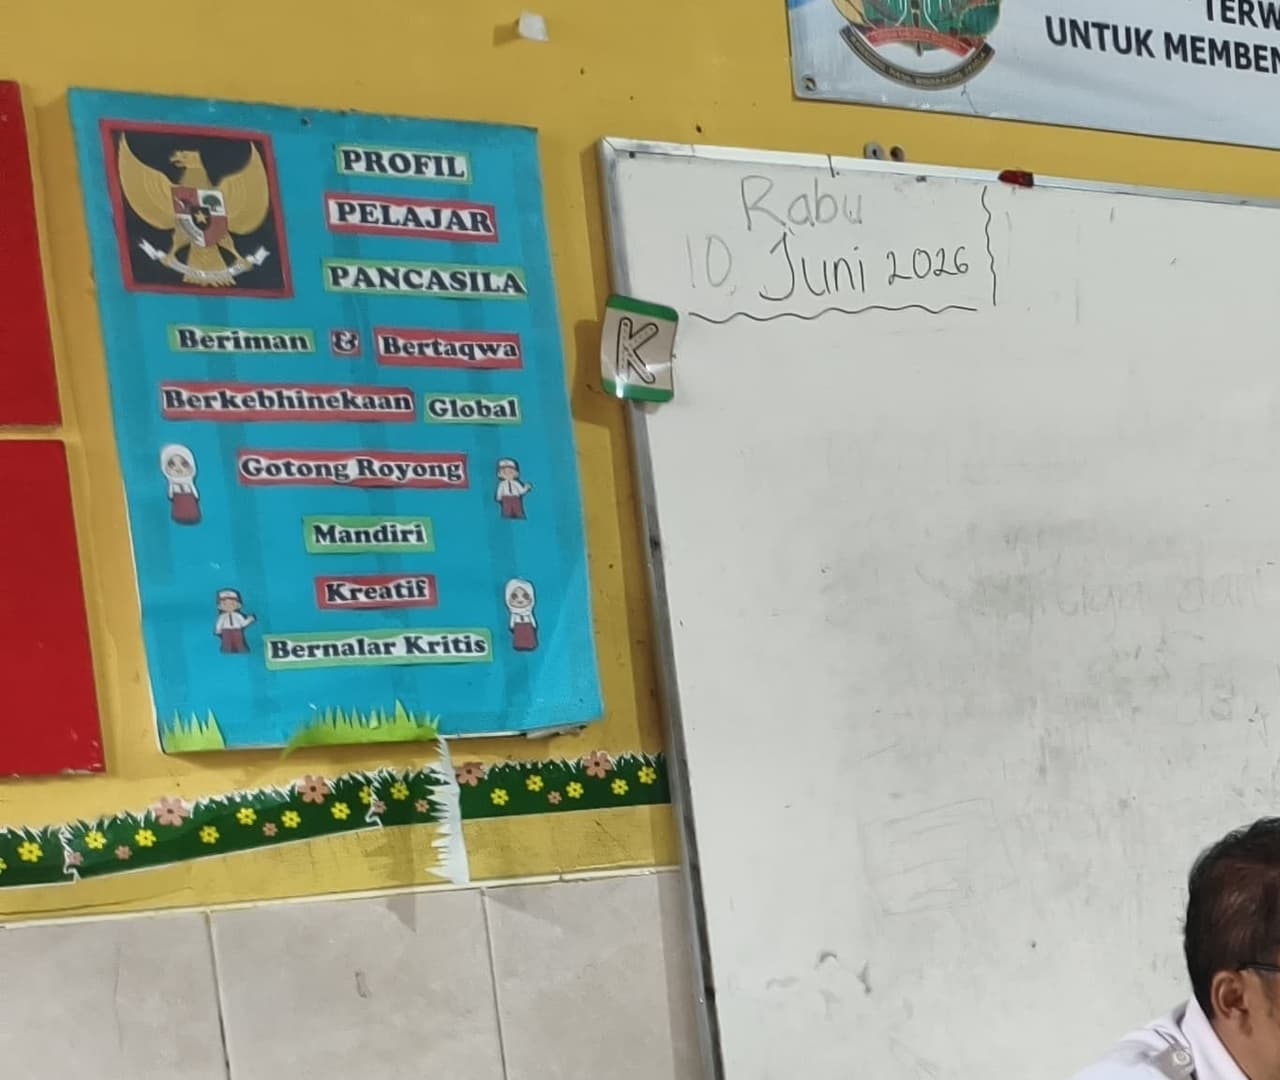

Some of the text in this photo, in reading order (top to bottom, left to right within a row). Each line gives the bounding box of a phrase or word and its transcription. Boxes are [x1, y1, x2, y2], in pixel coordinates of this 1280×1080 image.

[1045, 16, 1154, 59] UNTUK
[341, 148, 467, 180] PROFIL
[335, 201, 491, 235] PELAJAR
[741, 175, 862, 231] Rabu
[328, 265, 526, 295] PANCASILA
[759, 231, 865, 300] Juni
[887, 246, 968, 284] 2026
[177, 328, 519, 363] Beriman & Bertaqwa
[616, 315, 660, 384] K
[162, 388, 518, 420] Berkebhinekaan Global
[241, 456, 463, 484] Gotong Royong
[312, 521, 426, 546] Mandiri
[325, 577, 428, 602] Kreatif
[269, 633, 487, 660] Bernalar Kritis
